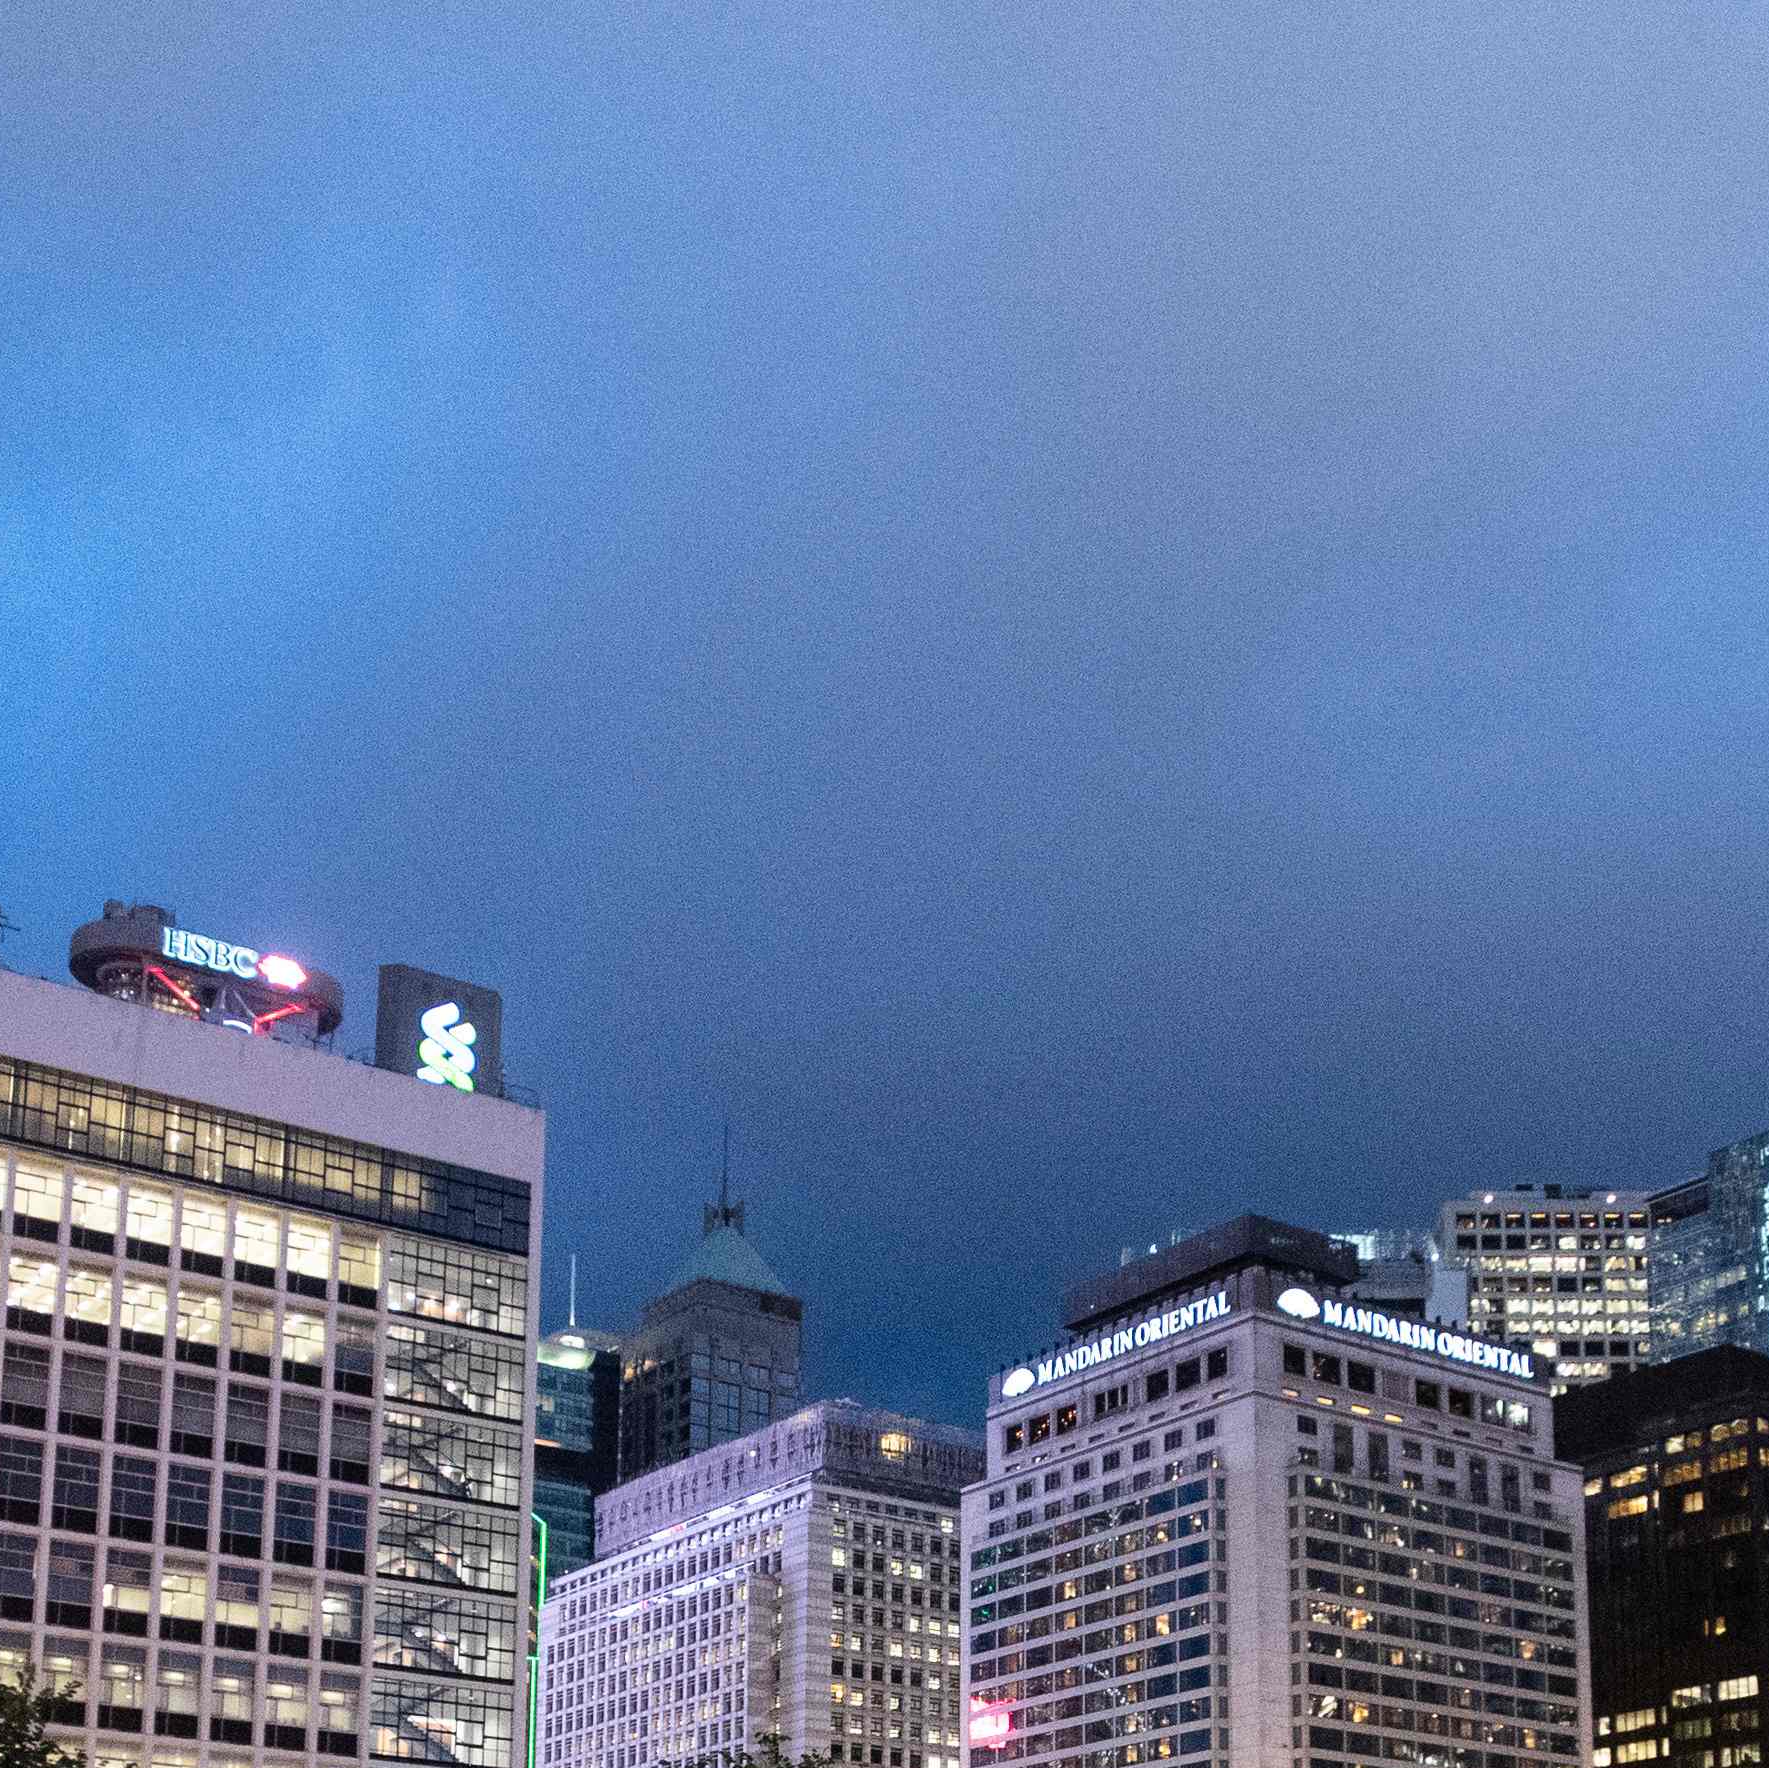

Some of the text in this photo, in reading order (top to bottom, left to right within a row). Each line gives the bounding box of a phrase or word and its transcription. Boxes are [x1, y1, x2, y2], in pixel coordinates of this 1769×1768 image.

[162, 926, 259, 979] HSBC
[1037, 1291, 1231, 1385] MANDARIN ORIENTAL
[1323, 1300, 1534, 1379] MANDARIN ORIENTAL
